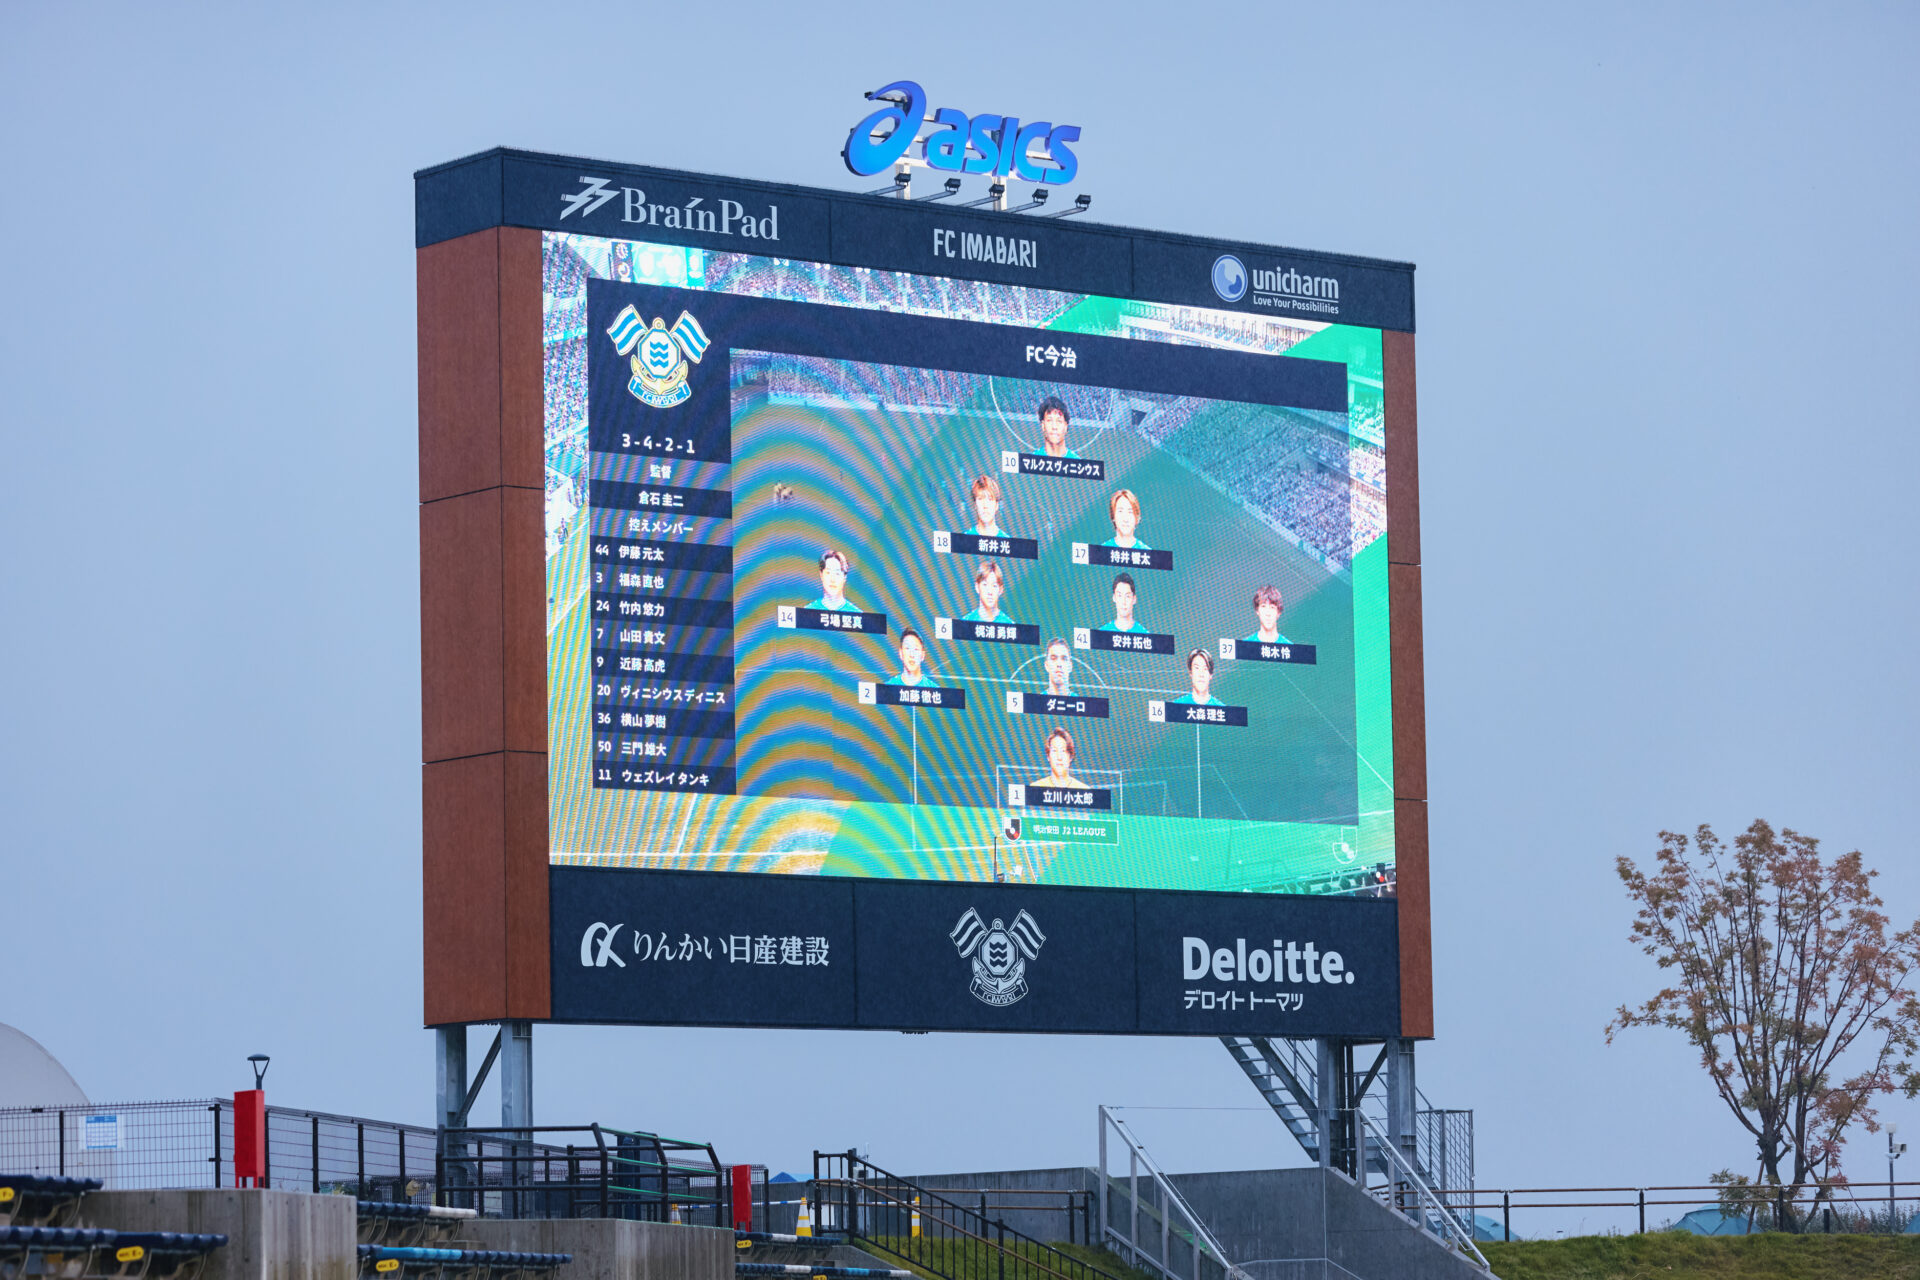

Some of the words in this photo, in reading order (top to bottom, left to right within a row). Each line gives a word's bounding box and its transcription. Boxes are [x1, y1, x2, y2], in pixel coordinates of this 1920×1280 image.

[922, 107, 1082, 186] asics
[933, 228, 956, 259] FC
[961, 232, 1037, 269] IMABARI
[1252, 265, 1339, 299] unicharm
[1253, 295, 1272, 306] Love
[1272, 298, 1290, 309] Your
[1292, 301, 1339, 315] Possibilities
[1025, 344, 1078, 369] FC今治
[1005, 457, 1017, 467] 10
[649, 464, 672, 480] 監督
[628, 518, 694, 535] 控えメンバー
[937, 536, 949, 547] 18
[595, 544, 609, 556] 44
[1075, 548, 1086, 559] 17
[595, 572, 603, 583] 3
[596, 600, 610, 612] 24
[780, 612, 794, 623] 14
[596, 628, 604, 640] 7
[940, 623, 947, 634] 6
[1076, 633, 1088, 644] 41
[1222, 643, 1233, 654] 37
[596, 656, 604, 668] 9
[597, 685, 611, 696] 20
[864, 688, 871, 698] 2
[1012, 697, 1019, 707] 5
[1047, 698, 1086, 713] ダニーロ
[1151, 705, 1163, 717] 16
[597, 713, 611, 725] 36
[598, 740, 612, 752] 50
[598, 769, 612, 781] 11
[1013, 789, 1020, 800] 1
[1062, 826, 1071, 836] J2
[1072, 827, 1107, 837] LEAGUE
[633, 929, 831, 968] りんかい日産建設
[1182, 936, 1355, 985] Deloitte.
[1183, 989, 1245, 1011] デロイト
[1250, 991, 1304, 1012] トーマツ
